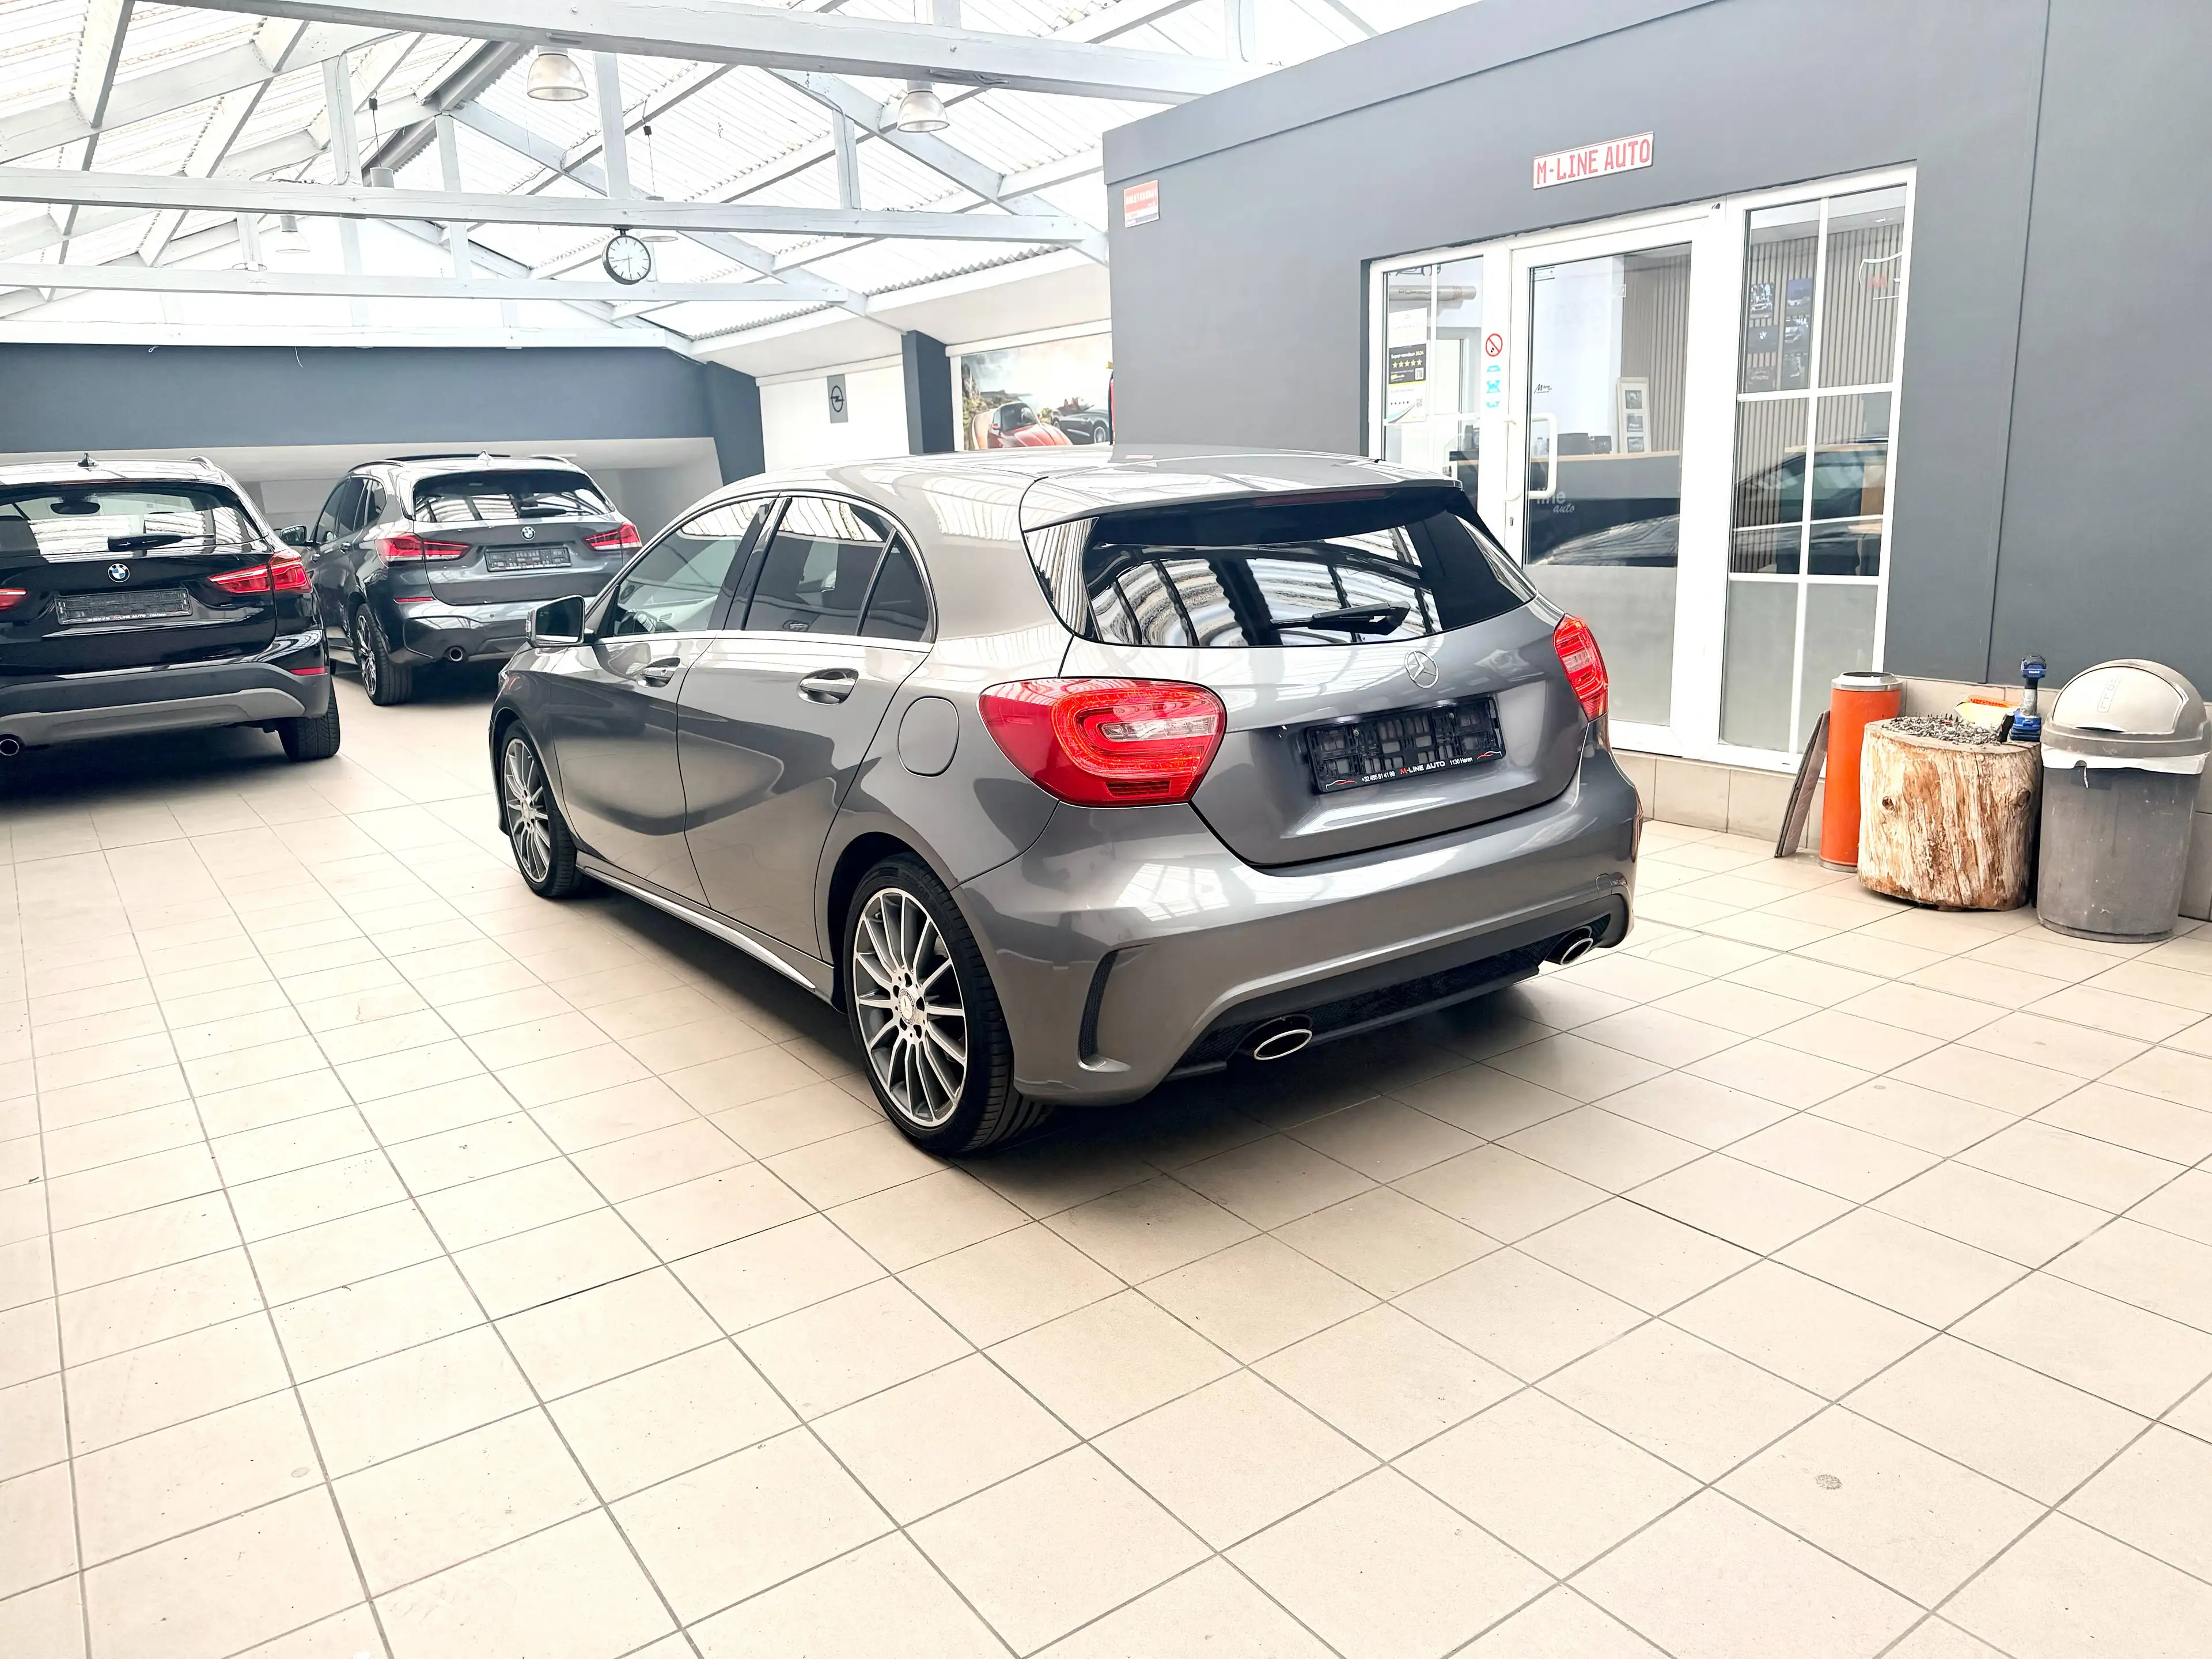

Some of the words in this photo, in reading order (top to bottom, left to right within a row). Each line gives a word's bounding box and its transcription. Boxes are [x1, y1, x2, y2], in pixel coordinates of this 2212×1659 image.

[1537, 149, 1599, 184] M-LINE
[1604, 139, 1650, 171] AUTO
[1552, 503, 1575, 513] auto
[1400, 764, 1425, 775] M-LINE
[1426, 760, 1446, 770] AUTO
[1460, 756, 1473, 764] Haren
